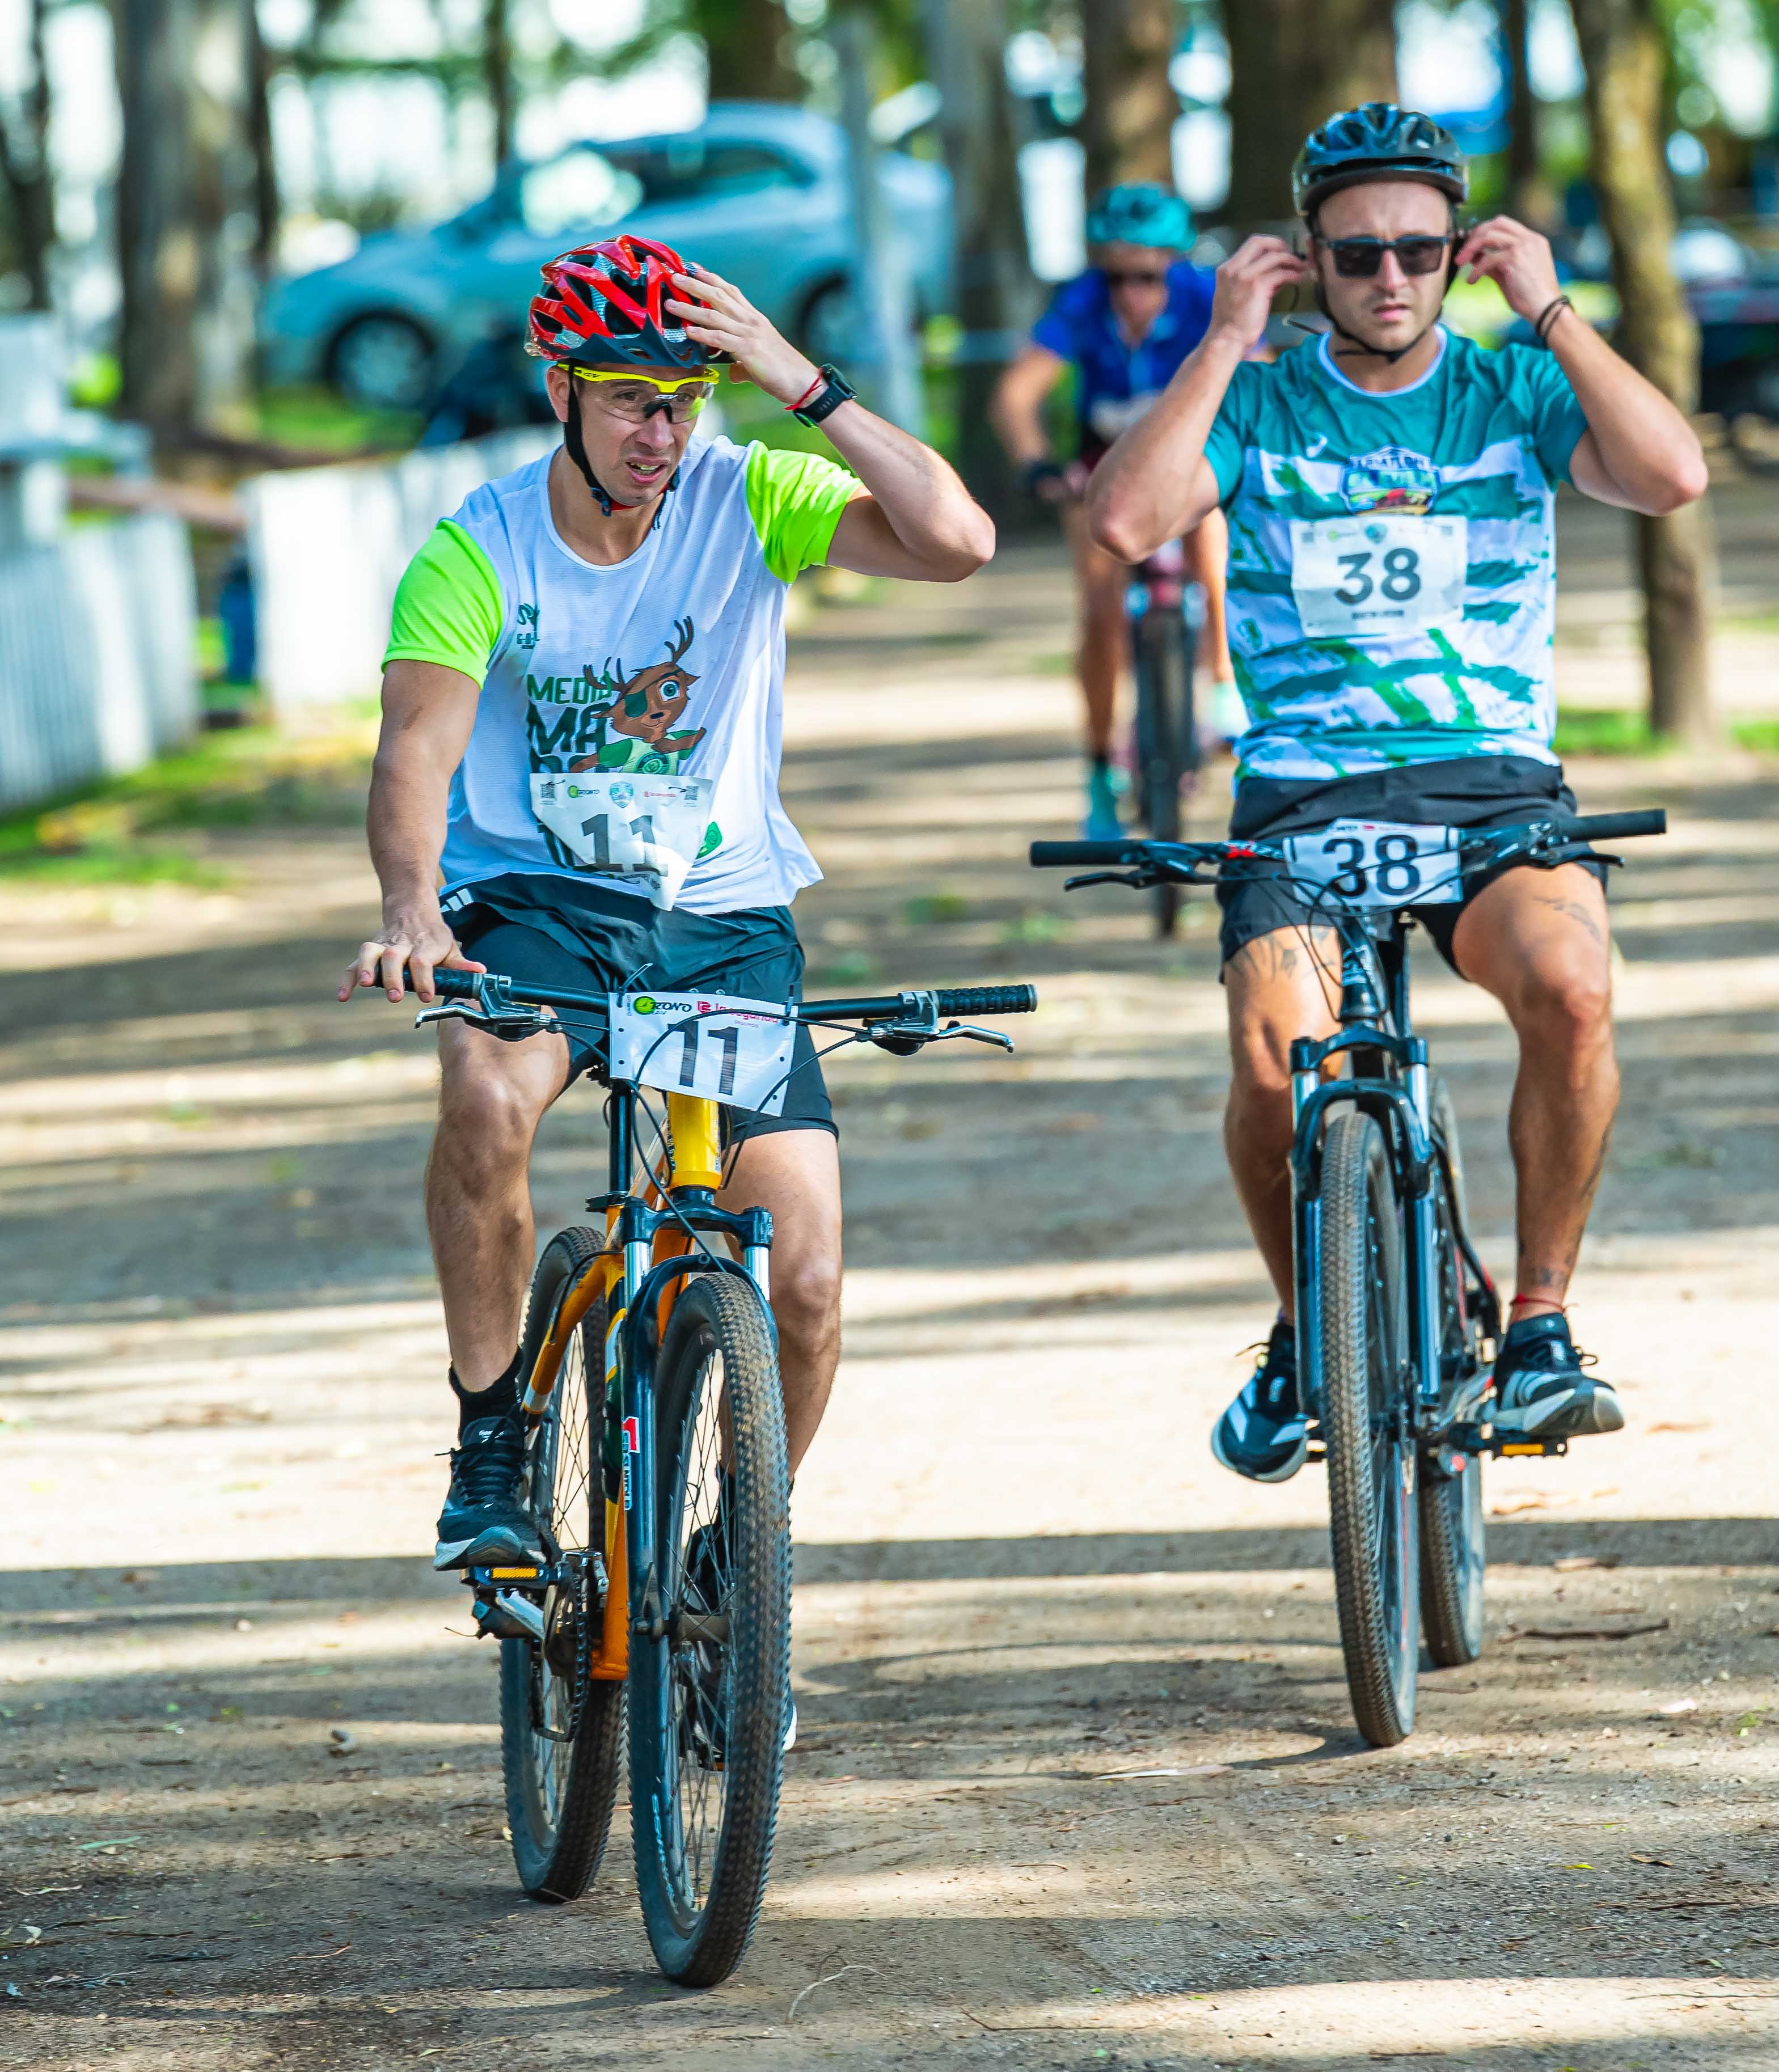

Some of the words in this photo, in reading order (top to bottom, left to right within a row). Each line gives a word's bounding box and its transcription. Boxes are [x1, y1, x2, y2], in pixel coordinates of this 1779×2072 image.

[1334, 548, 1421, 606] 38
[581, 814, 669, 877] 11
[1323, 835, 1420, 898] 38
[667, 1020, 740, 1096] 11
